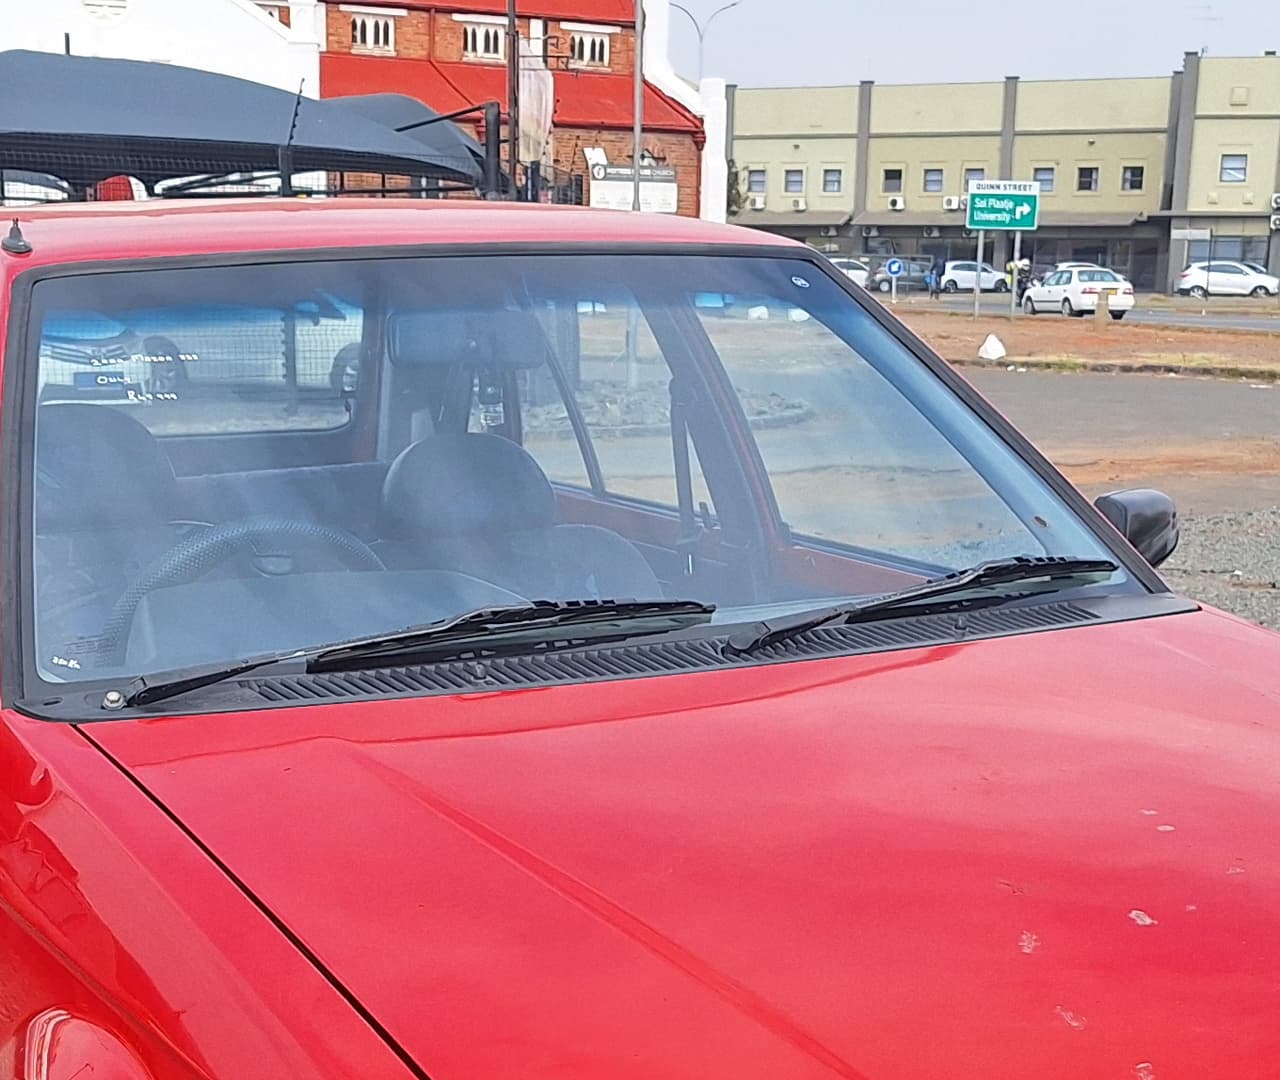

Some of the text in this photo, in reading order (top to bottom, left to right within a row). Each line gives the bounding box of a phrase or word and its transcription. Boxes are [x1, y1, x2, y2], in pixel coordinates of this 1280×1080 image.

[976, 183, 1032, 192] QUINN STREET
[973, 209, 1011, 224] University
